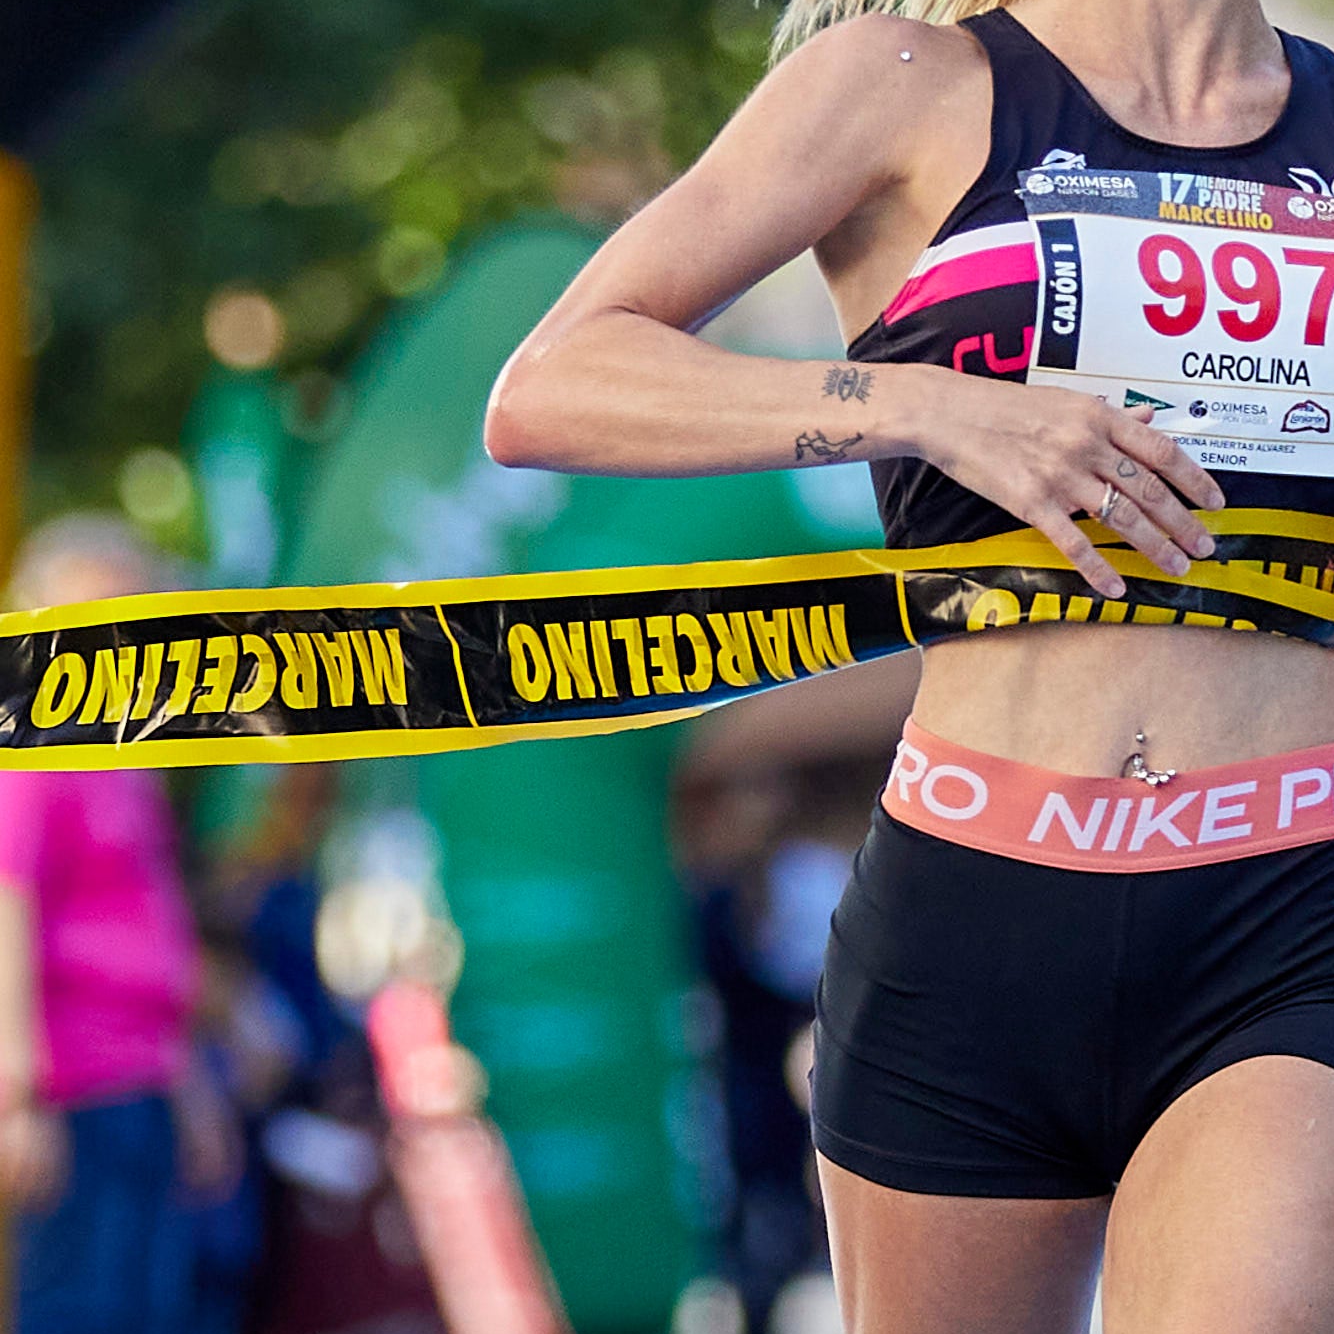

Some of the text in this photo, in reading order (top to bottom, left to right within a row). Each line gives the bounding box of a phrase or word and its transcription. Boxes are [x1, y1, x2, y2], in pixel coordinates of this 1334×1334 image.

[1054, 175, 1136, 189] OXIMESA
[1157, 172, 1265, 204] 17 MEMORIAL
[1158, 201, 1273, 230] MARCELINO
[1198, 189, 1262, 213] PADRE
[1050, 244, 1078, 335] CAJÓN 1
[1181, 351, 1311, 386] CAROLINA
[1211, 401, 1268, 416] OXIMESA
[1200, 452, 1247, 466] SENIOR
[1209, 439, 1255, 451] HUERTAS
[1256, 444, 1296, 454] ALVAREZ
[508, 604, 856, 703] MARCELINO
[31, 628, 409, 728] MARCELINO
[1027, 781, 1257, 852] NIKE
